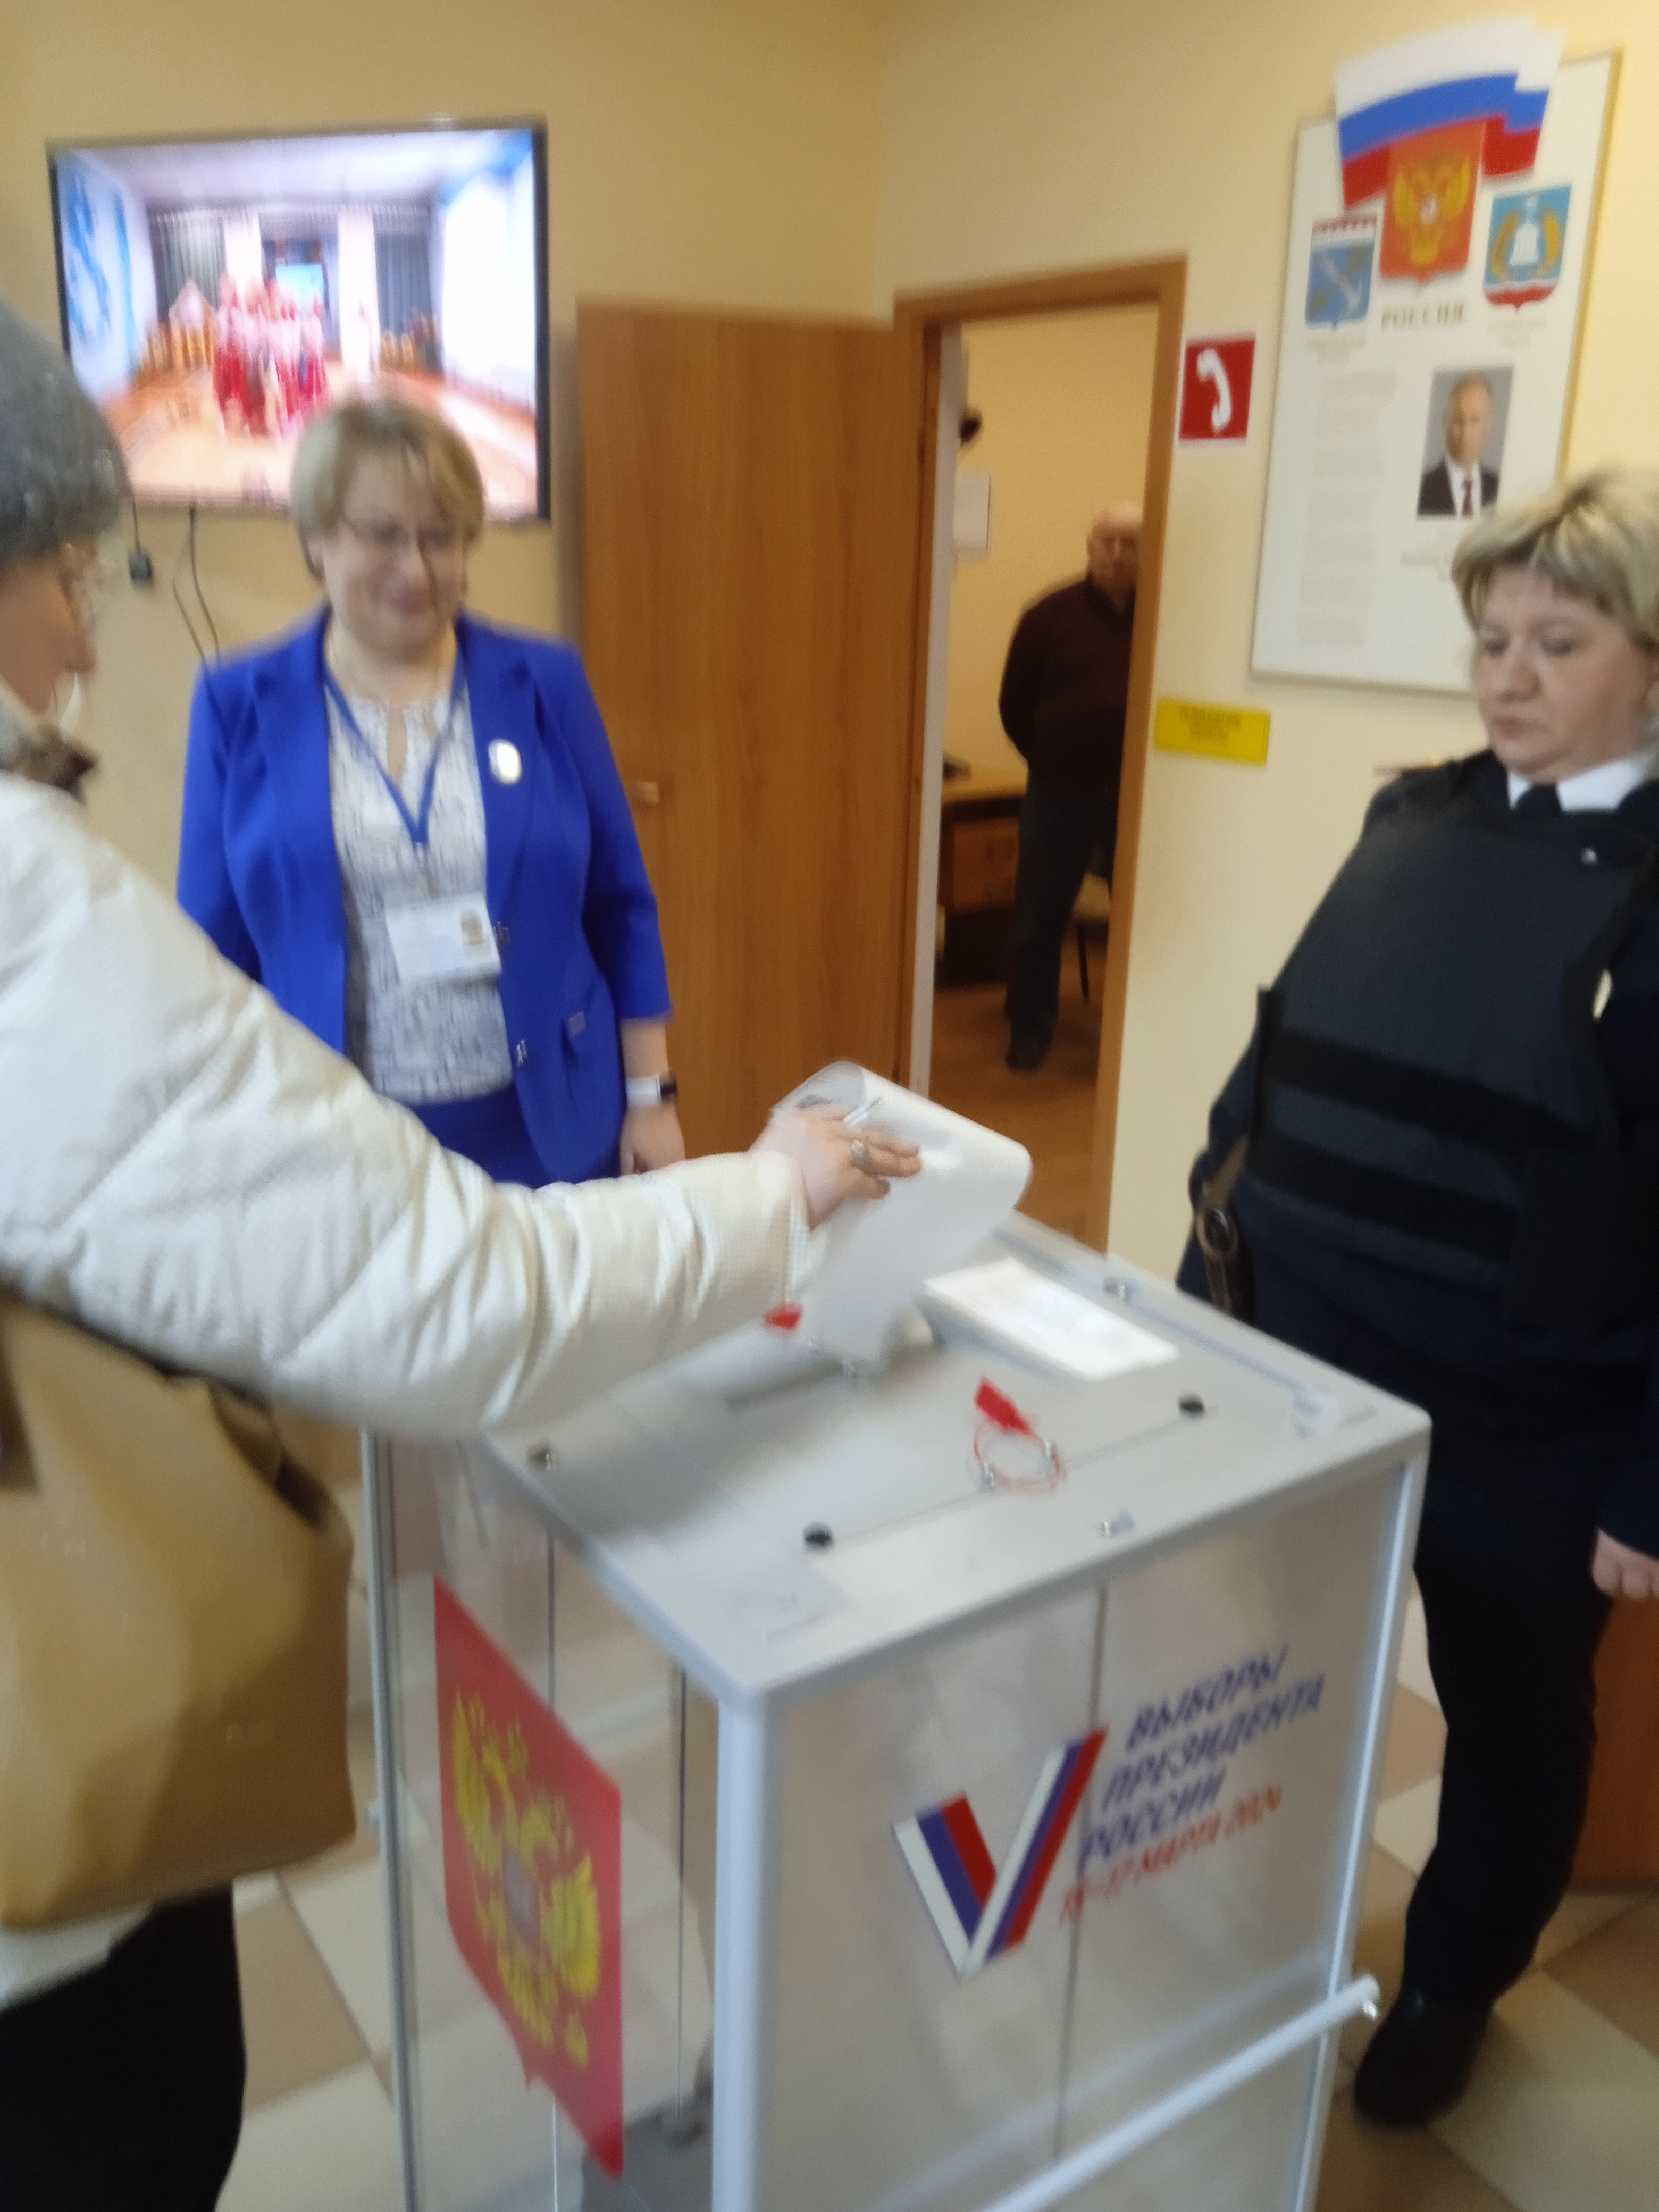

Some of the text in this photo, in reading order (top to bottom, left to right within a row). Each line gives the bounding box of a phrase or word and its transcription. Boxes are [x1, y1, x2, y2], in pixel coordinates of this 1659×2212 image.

[1102, 1672, 1326, 1813] ПРЕЗИДЕНТА
[1126, 1644, 1289, 1750] ВЫБОРЫ
[1076, 1765, 1227, 1879] РОССИИ
